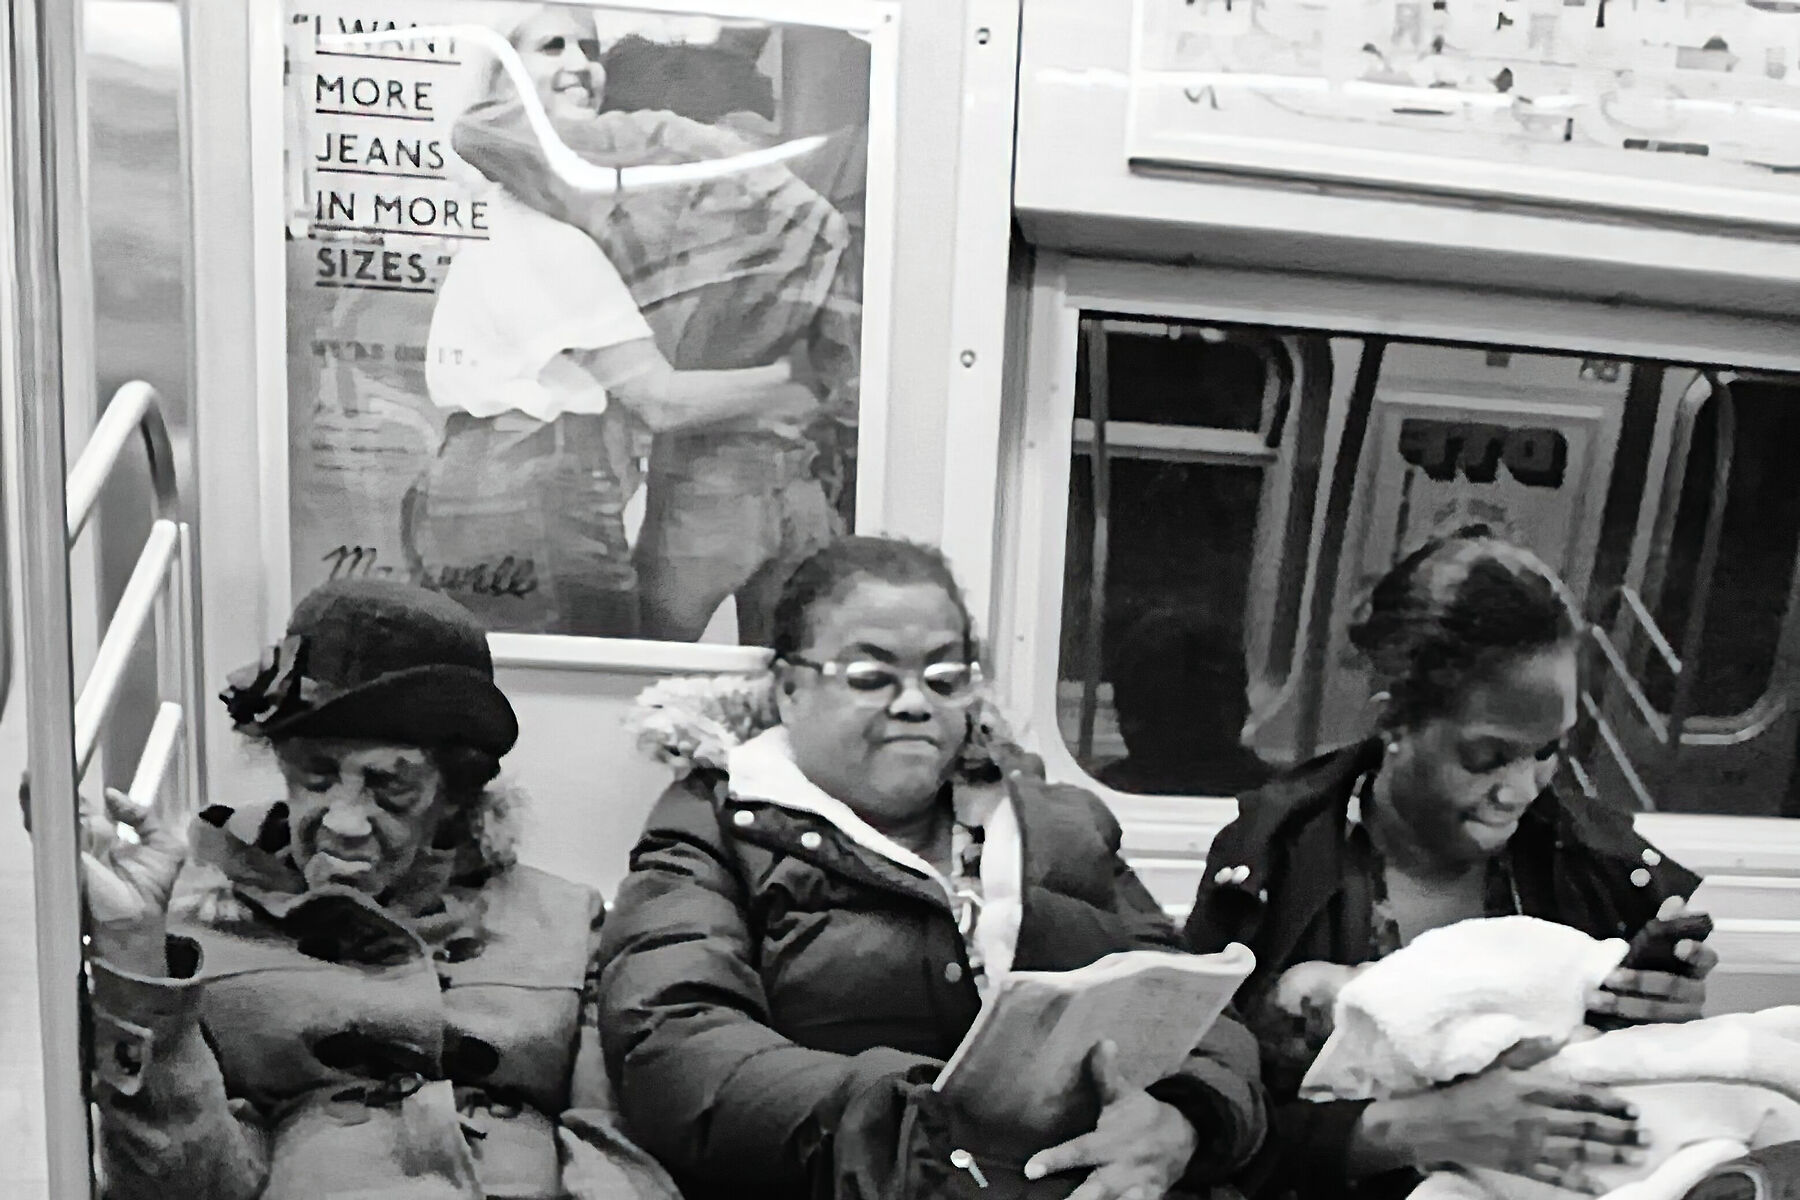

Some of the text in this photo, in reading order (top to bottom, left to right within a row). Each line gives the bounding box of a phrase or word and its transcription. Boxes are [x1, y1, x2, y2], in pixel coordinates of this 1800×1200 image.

[315, 74, 433, 111] MORE
[315, 133, 445, 170] JEANS
[315, 190, 489, 230] IN MORE
